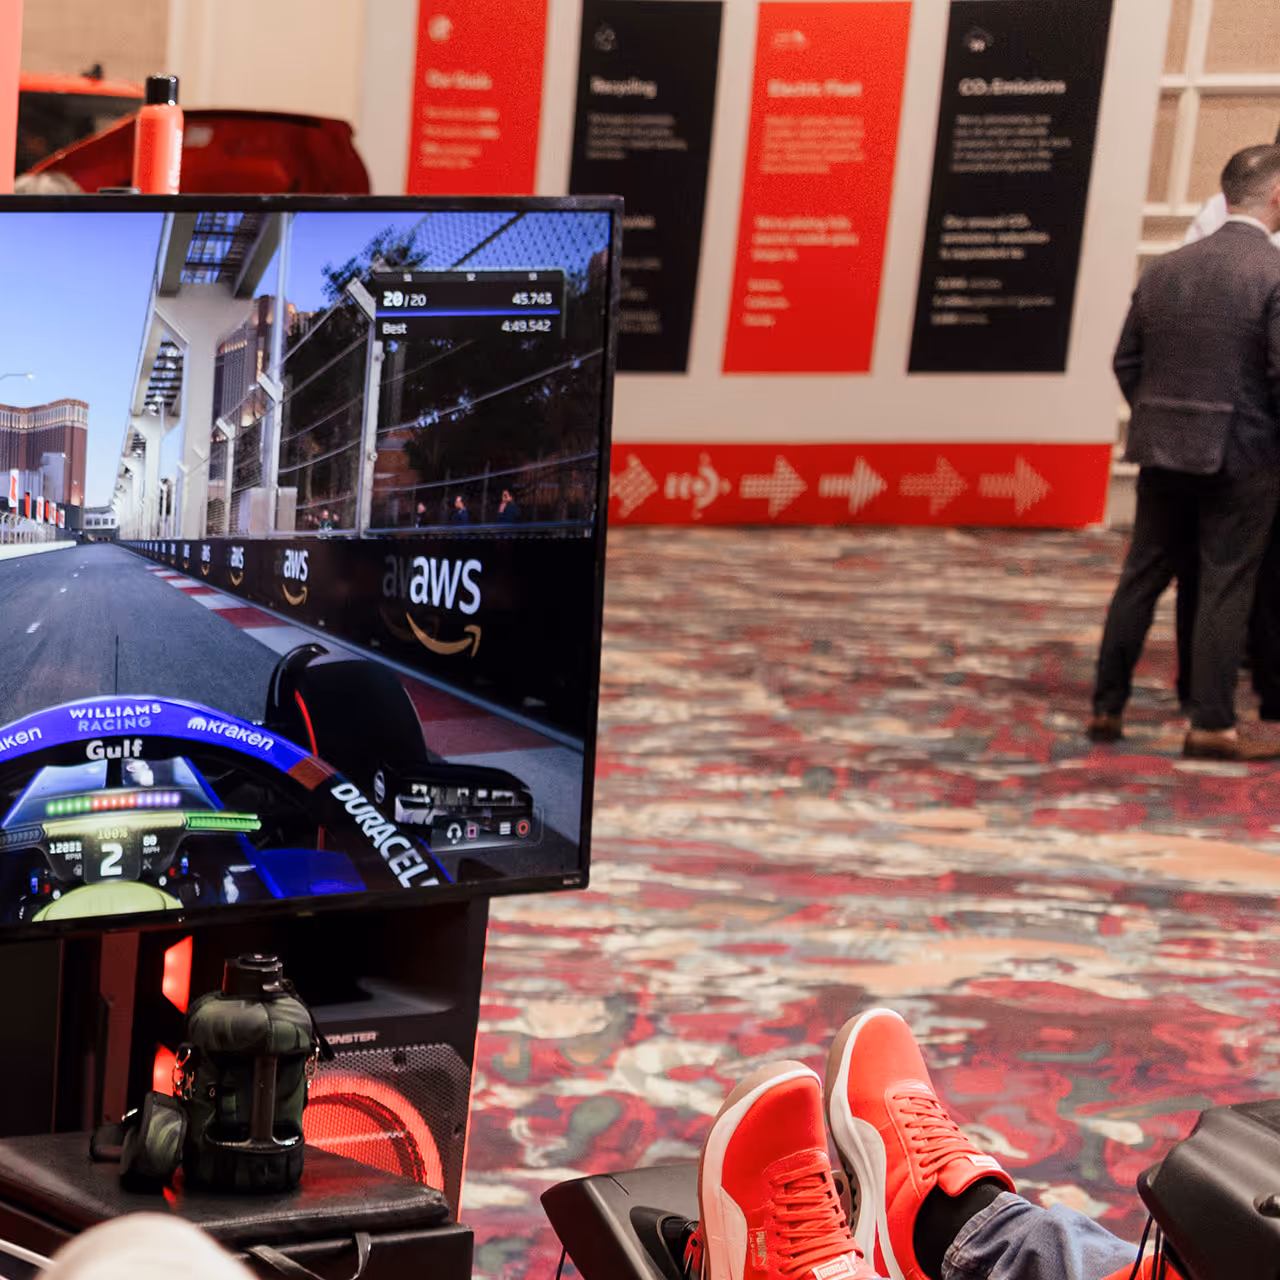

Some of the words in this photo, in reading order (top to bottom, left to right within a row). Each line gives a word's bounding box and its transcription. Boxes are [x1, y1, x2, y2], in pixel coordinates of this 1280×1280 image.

[382, 322, 408, 335] Best
[283, 549, 309, 582] aws
[409, 555, 482, 616] aws
[69, 704, 162, 719] WILLIAMS
[78, 716, 152, 732] RACING
[208, 718, 275, 751] kraken
[86, 739, 143, 760] Gulf
[100, 842, 123, 876] 2
[325, 1031, 377, 1044] ONSTER
